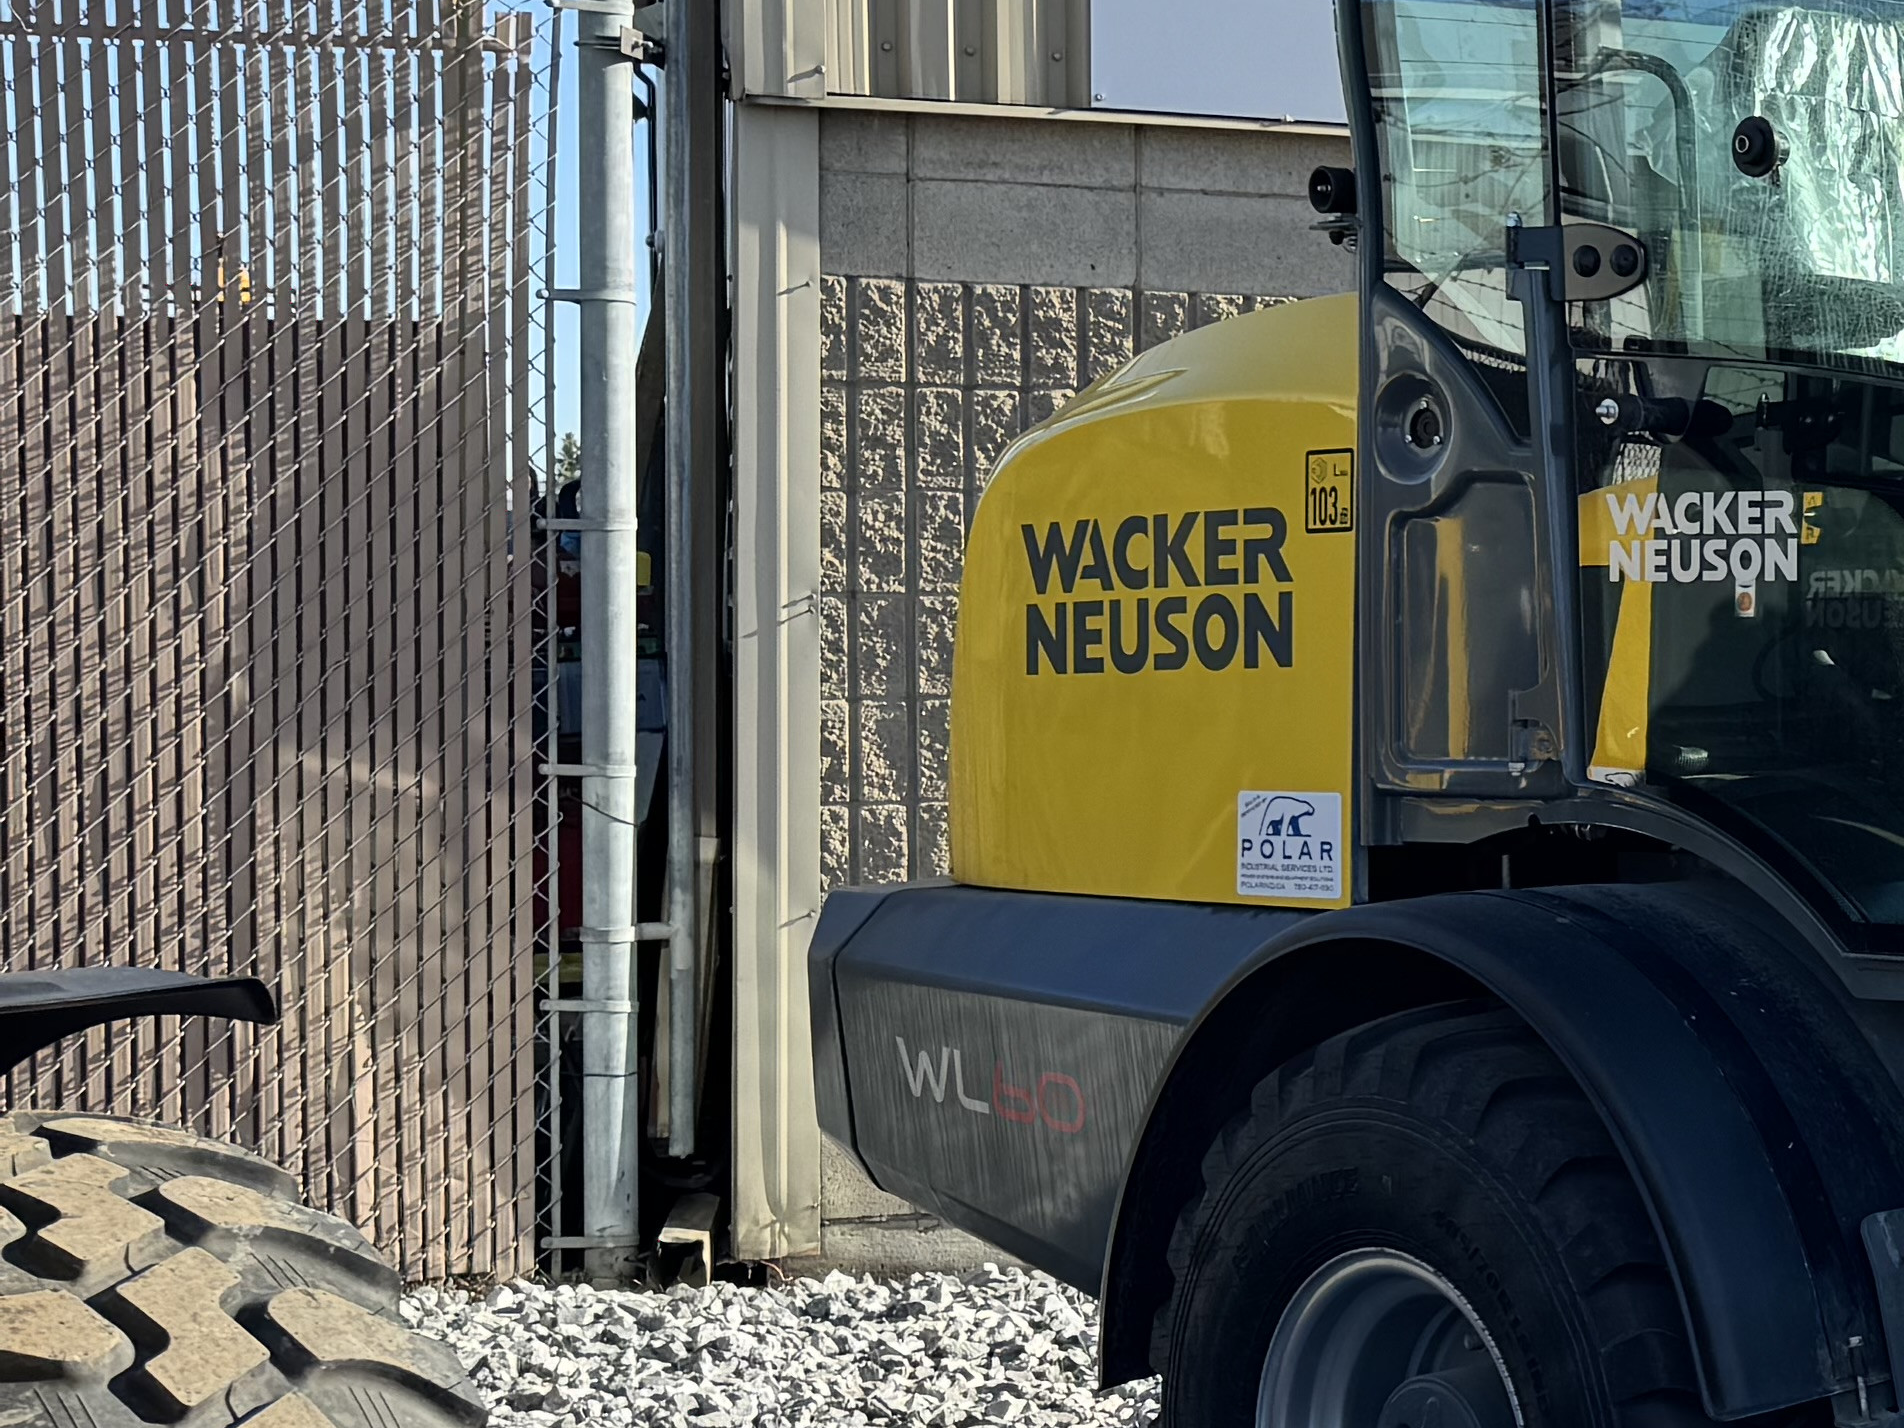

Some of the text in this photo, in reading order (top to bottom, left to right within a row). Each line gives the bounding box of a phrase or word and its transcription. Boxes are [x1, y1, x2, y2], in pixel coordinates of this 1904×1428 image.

[1309, 485, 1338, 526] 103
[1605, 489, 1798, 536] WACKER
[1020, 506, 1294, 595] WACKER
[1608, 536, 1799, 582] NEUSON
[1025, 590, 1294, 676] NEUSON
[1241, 838, 1333, 861] POLAR
[896, 1035, 1086, 1135] WL60
